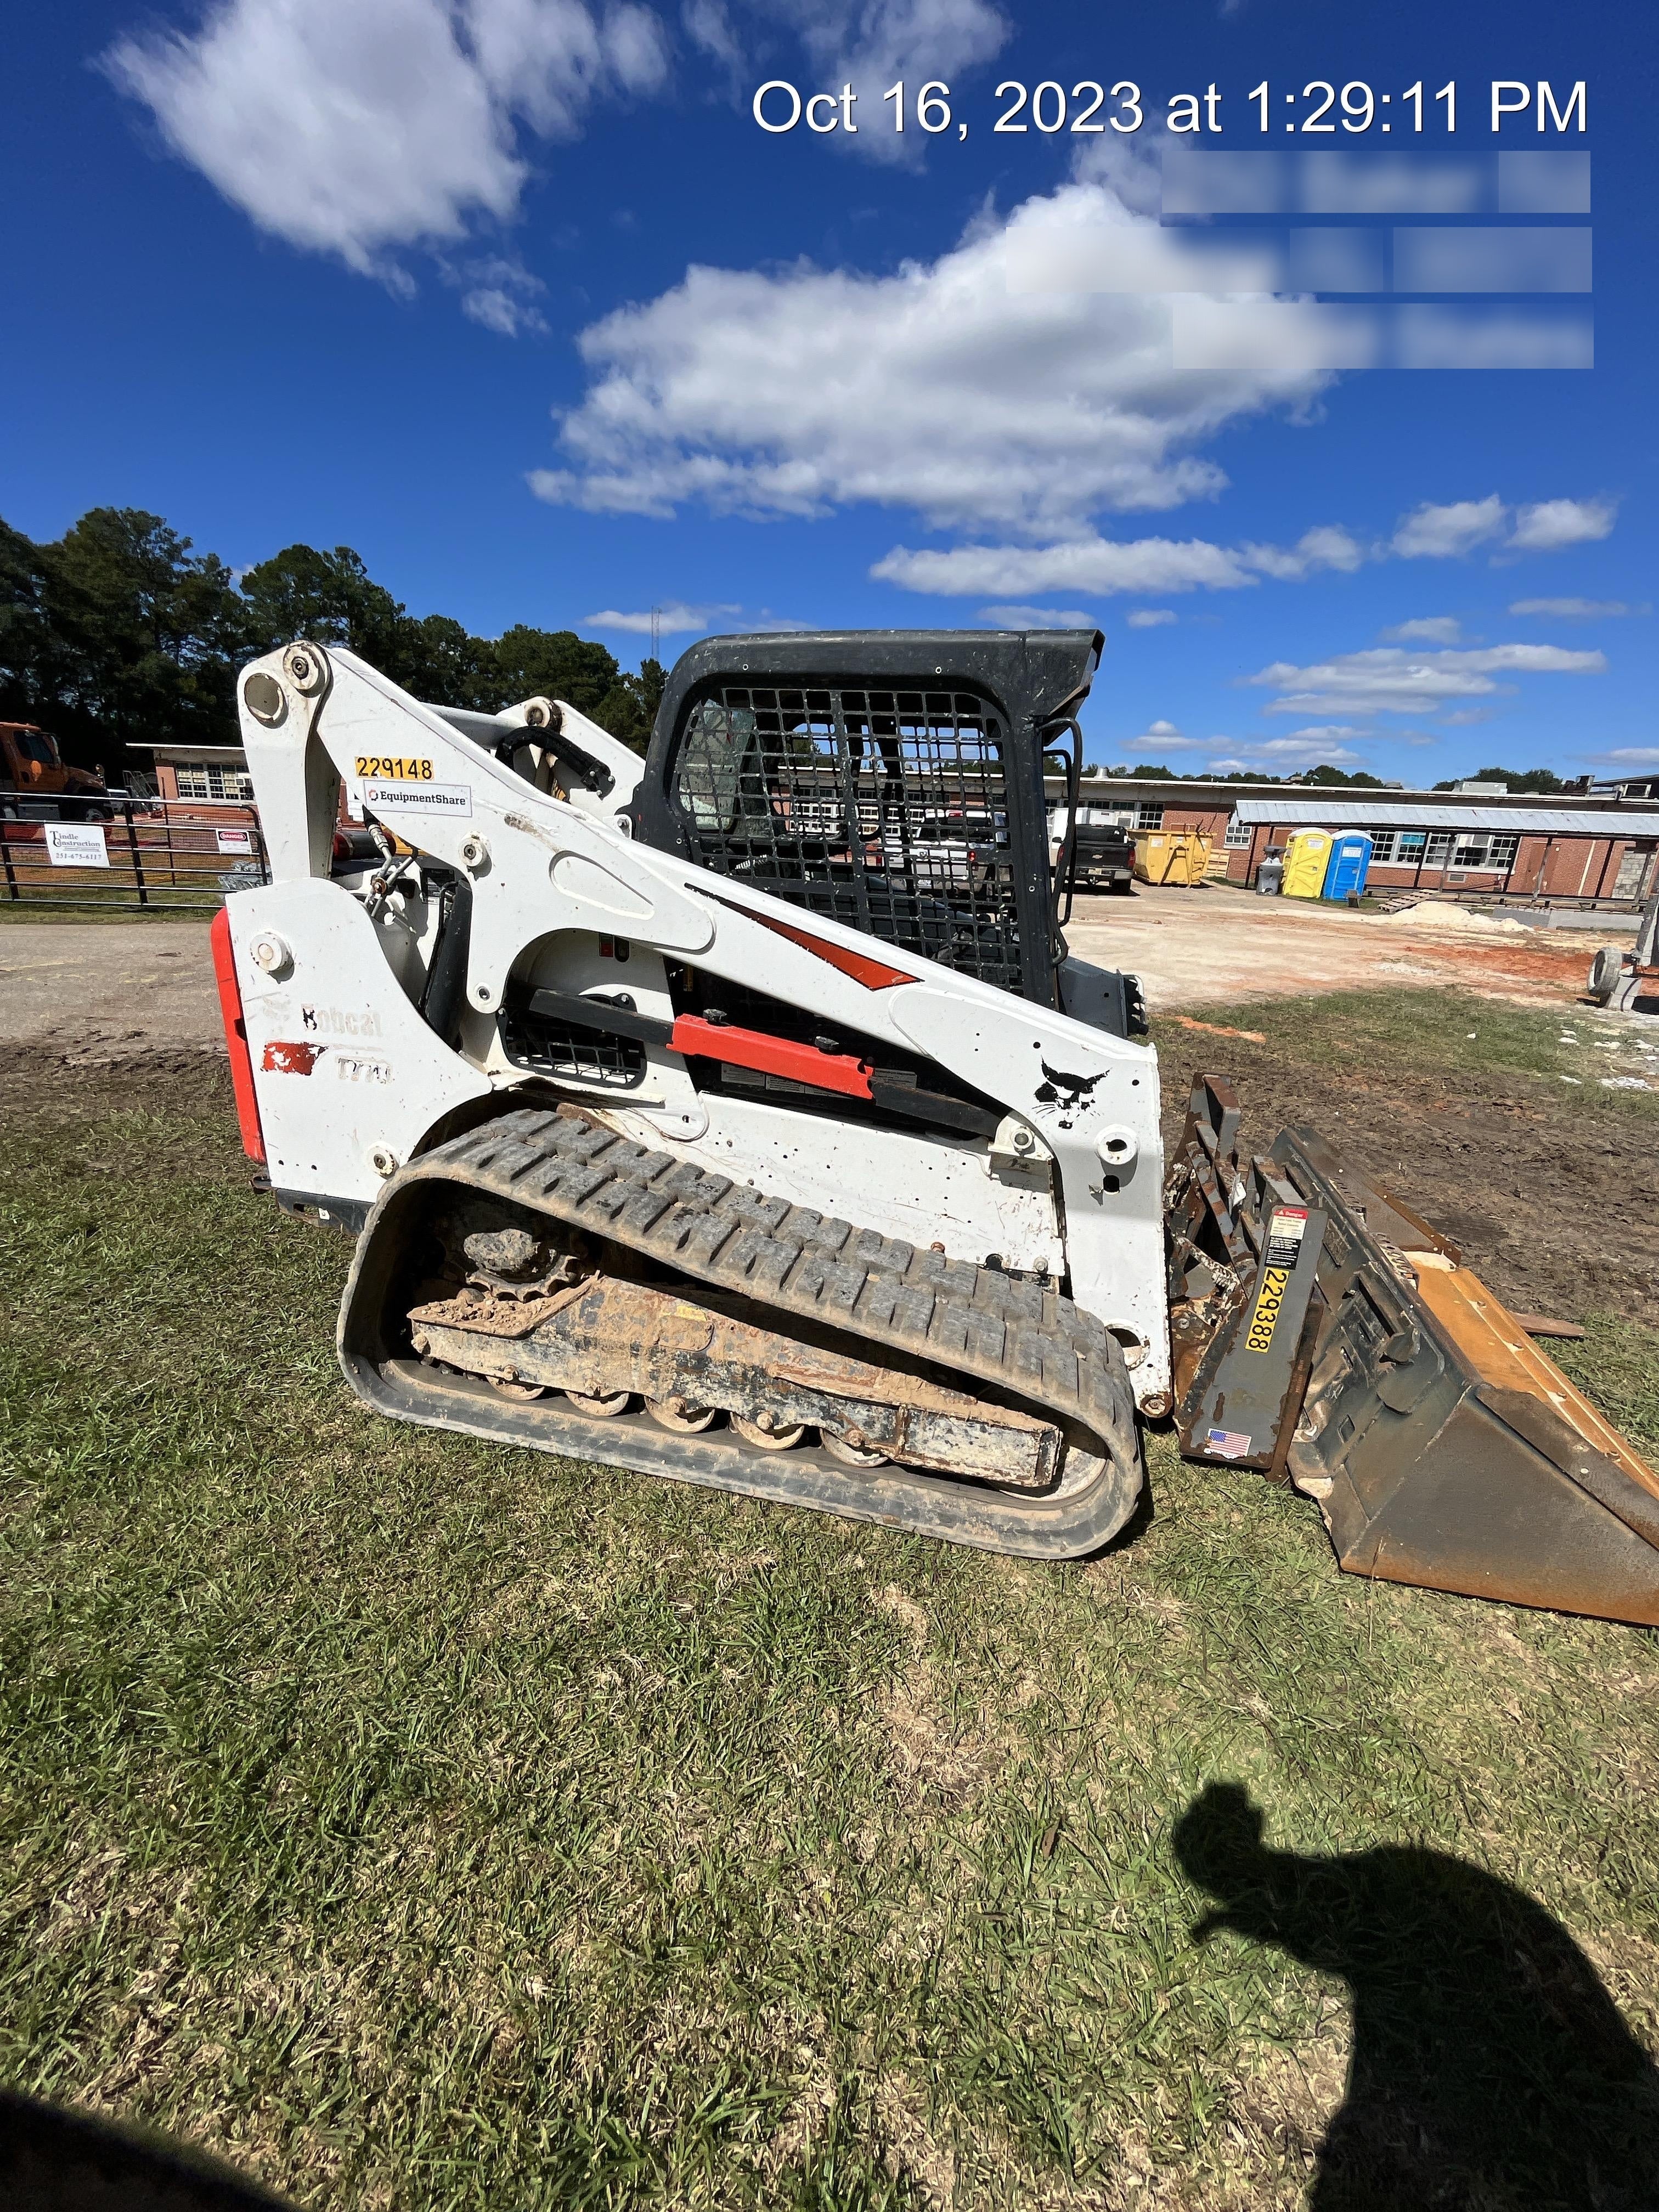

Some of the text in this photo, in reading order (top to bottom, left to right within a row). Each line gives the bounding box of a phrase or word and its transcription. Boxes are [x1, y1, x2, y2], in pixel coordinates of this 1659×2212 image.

[357, 757, 432, 780] 229148
[380, 791, 466, 805] EquipmentShare
[49, 831, 78, 840] Tindle
[53, 838, 100, 847] Construction
[1249, 1269, 1287, 1350] 229388
